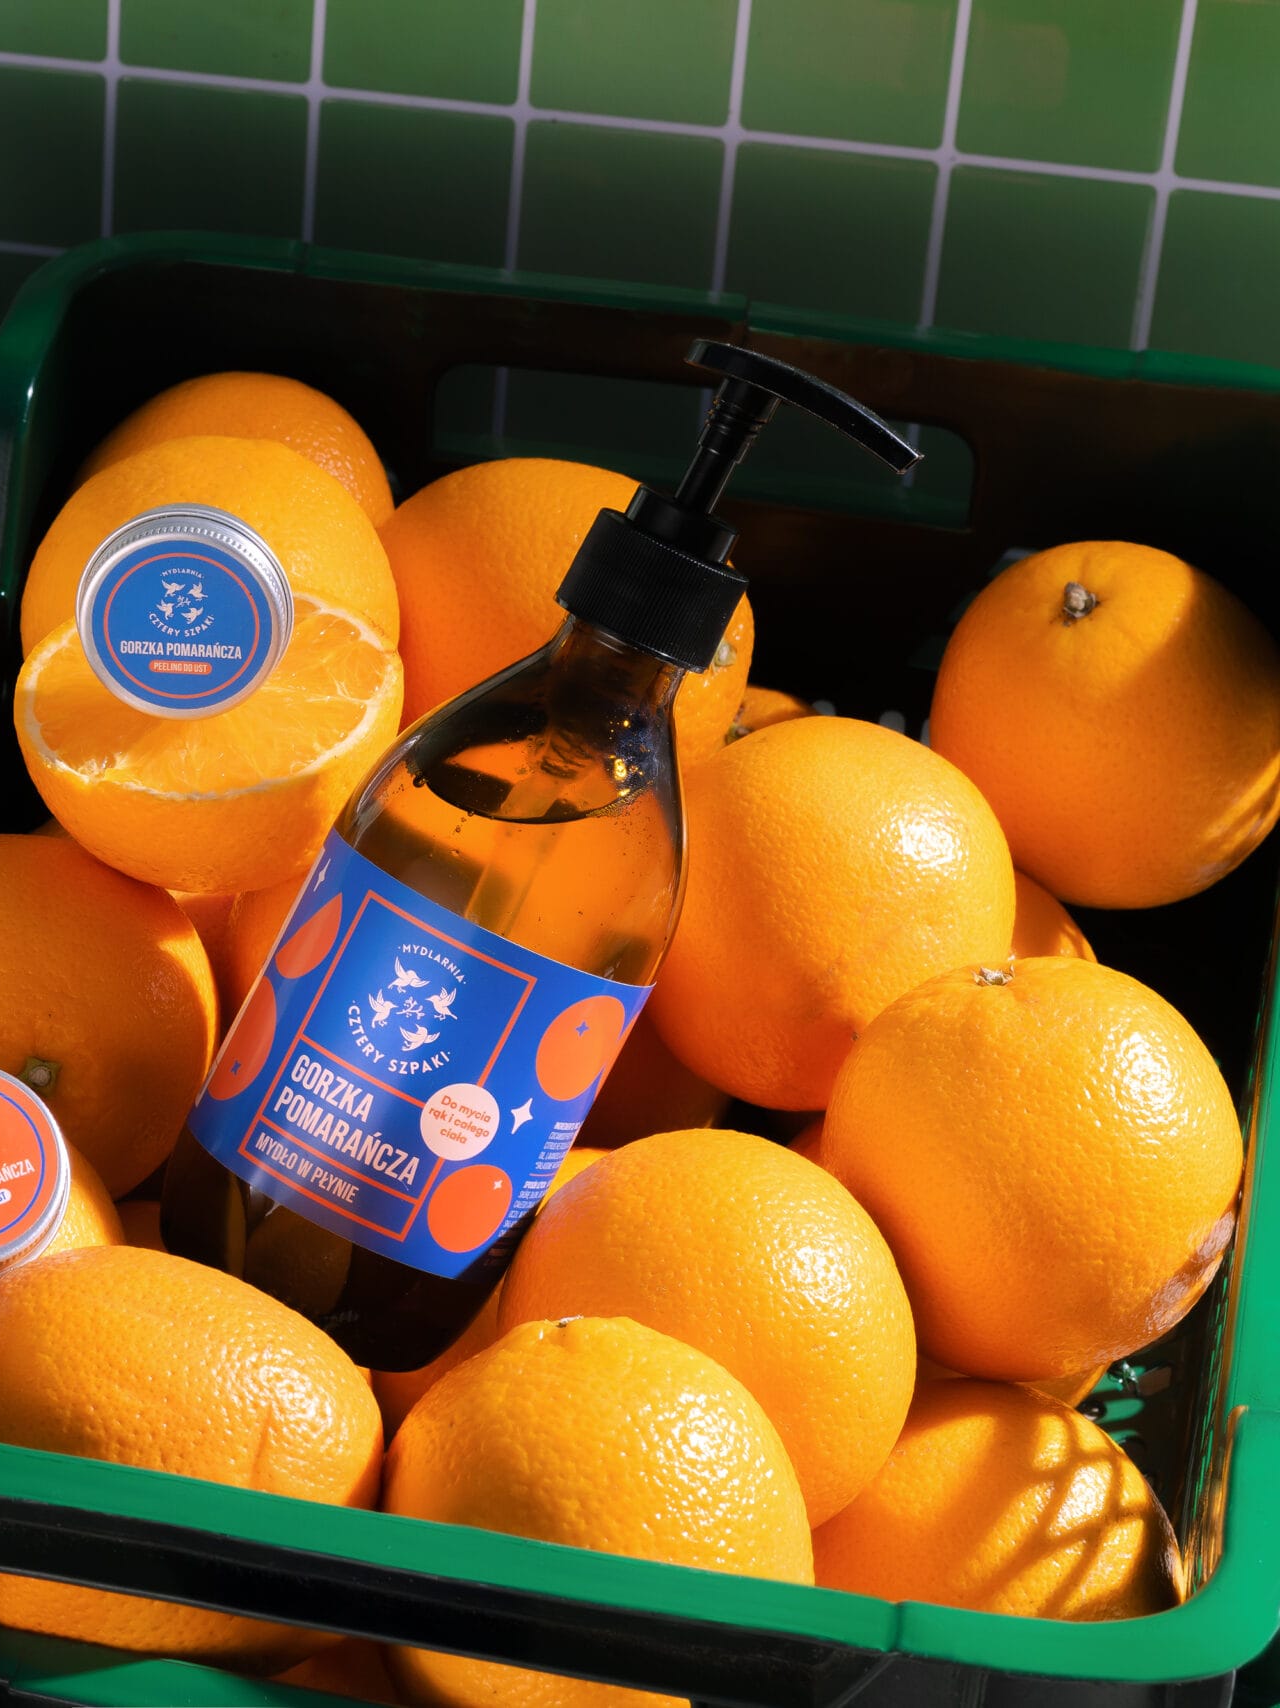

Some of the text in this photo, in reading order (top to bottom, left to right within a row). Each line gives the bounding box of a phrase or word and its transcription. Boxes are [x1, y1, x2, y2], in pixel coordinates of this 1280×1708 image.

[120, 640, 242, 659] GORZKA POMARAŃCZA
[153, 662, 208, 673] PEELING DO UST
[402, 944, 465, 983] MYDLARNIA
[348, 1005, 450, 1075] CZTERY SZPAKI
[290, 1054, 374, 1123] GORZKA
[429, 1107, 490, 1137] rąk i całego
[441, 1095, 491, 1123] Do mycia
[273, 1085, 420, 1187] POMARAŃCZA
[440, 1128, 468, 1144] ciała
[255, 1132, 360, 1204] MYDŁO W PŁYNIE
